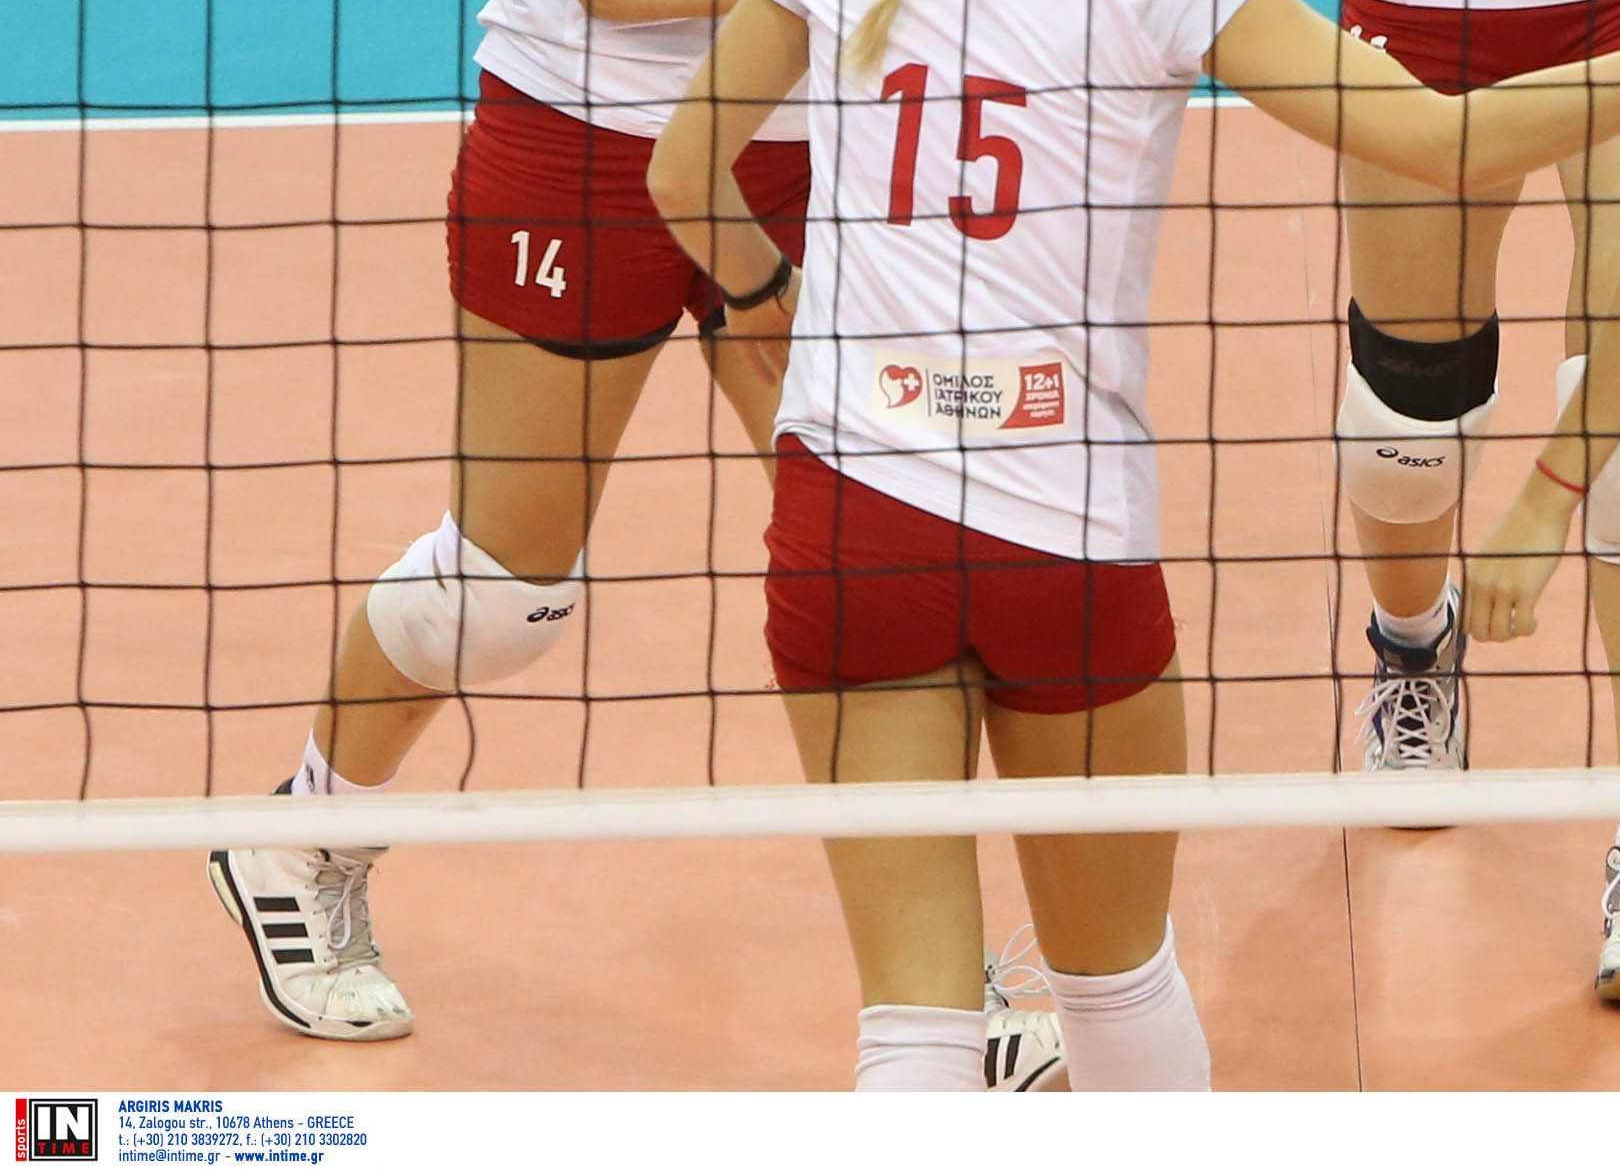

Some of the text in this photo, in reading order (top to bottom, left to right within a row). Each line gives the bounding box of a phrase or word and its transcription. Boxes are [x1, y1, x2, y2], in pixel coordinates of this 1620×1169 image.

[880, 62, 1027, 241] 15
[511, 230, 567, 298] 14
[1024, 372, 1059, 391] 12+1
[935, 389, 1004, 405] ΙΑΤΡΙΚΟΥ
[935, 404, 1002, 419] ΑΘΗΝΩΝ
[1397, 455, 1446, 468] asics
